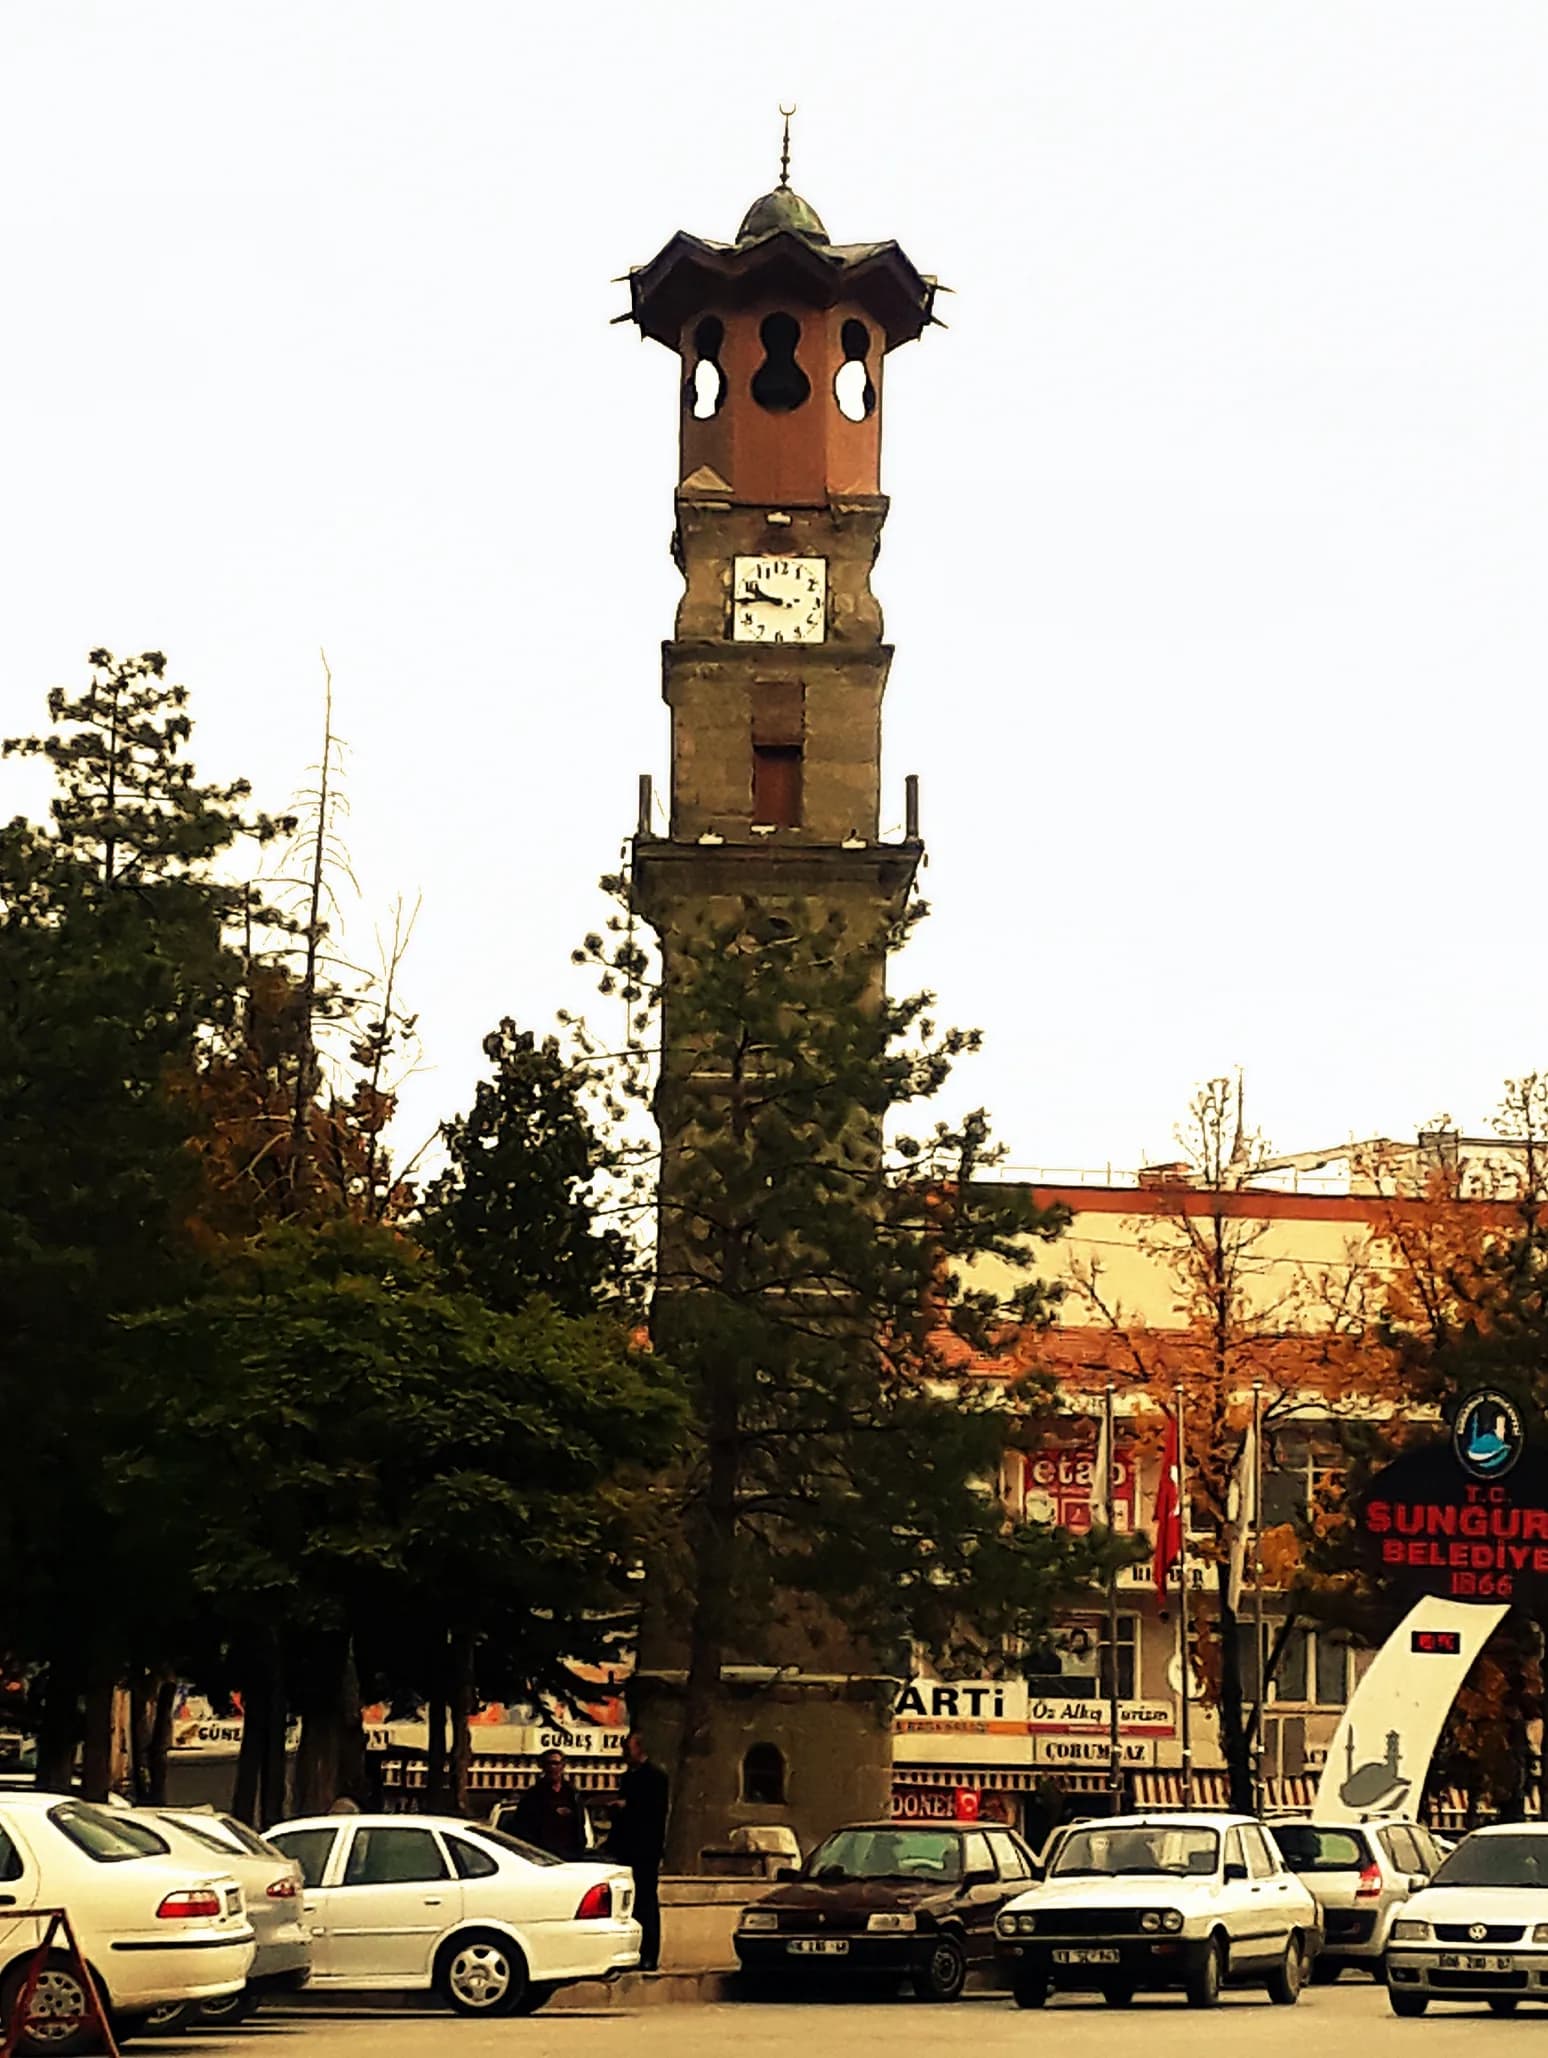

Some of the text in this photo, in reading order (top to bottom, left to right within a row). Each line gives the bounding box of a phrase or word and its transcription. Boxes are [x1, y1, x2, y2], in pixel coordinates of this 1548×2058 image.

[757, 564, 770, 579] 11
[774, 561, 788, 575] 12
[1367, 1500, 1548, 1540] SUNGUR
[1452, 1571, 1513, 1596] 1866
